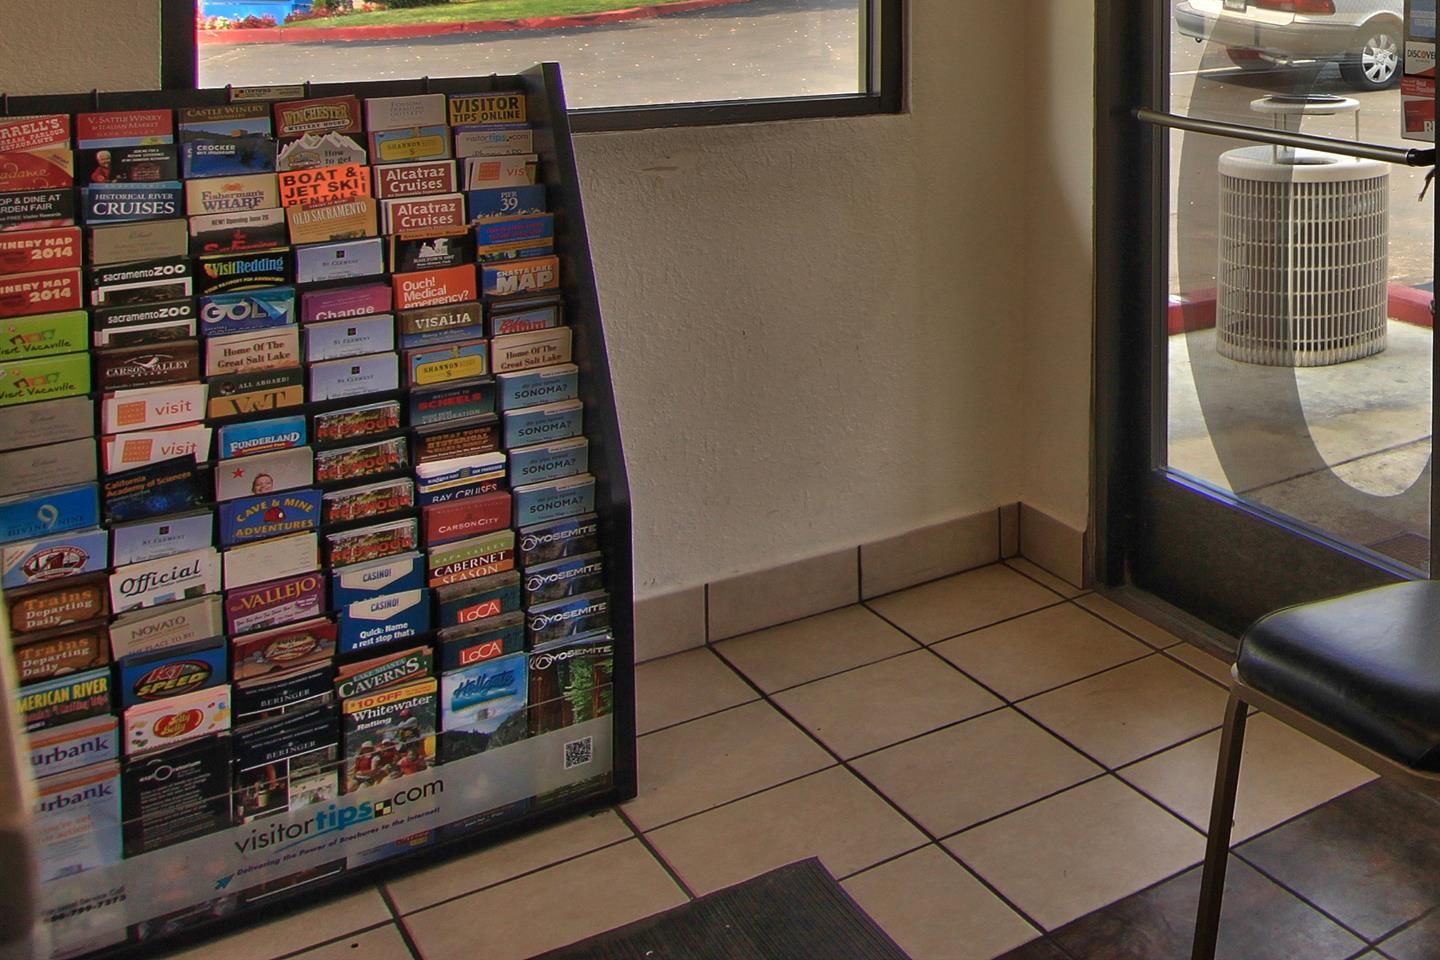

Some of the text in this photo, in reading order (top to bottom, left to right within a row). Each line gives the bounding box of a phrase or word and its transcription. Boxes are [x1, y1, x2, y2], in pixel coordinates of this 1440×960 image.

[1407, 49, 1435, 59] DISCOVE
[187, 107, 222, 117] CASTLE
[224, 105, 263, 114] WINERY
[453, 97, 519, 113] VISITOR
[282, 104, 349, 125] WINCHESTER
[454, 110, 520, 122] TIPS ONLINE
[0, 119, 60, 139] RRELL'S
[283, 167, 356, 186] BOAT &
[386, 167, 445, 181] Alcatraz
[285, 179, 358, 198] JET SKI
[390, 179, 442, 192] Cruises
[23, 195, 46, 204] DINE
[201, 190, 264, 200] Fisherman's
[30, 203, 52, 211] FAIR
[93, 201, 175, 216] CRUISES
[203, 197, 264, 212] WHARF
[398, 203, 456, 215] Alcatraz
[501, 197, 518, 211] 39
[293, 212, 310, 225] OLD
[311, 202, 367, 222] SACRAMENTO
[402, 214, 454, 228] Cruises
[0, 237, 72, 250] INERY MAP
[32, 247, 72, 259] 2014
[496, 268, 529, 279] SHASTA
[496, 271, 553, 292] MAP
[0, 279, 71, 294] INERY MAP
[403, 277, 435, 291] Ouch!
[29, 288, 71, 302] 2014
[404, 285, 447, 302] Medical
[404, 290, 469, 309] emergency?
[201, 298, 280, 323] GOL
[415, 313, 472, 328] VISALIA
[24, 339, 71, 351] Vacaville
[223, 341, 284, 357] Home Of The
[506, 345, 557, 360] Home Of The
[218, 351, 290, 368] Great Salt Lake
[501, 354, 562, 370] Great Salt Lake
[106, 360, 189, 377] CARSON VALLEY
[27, 383, 76, 395] Vacaville
[256, 377, 289, 386] ABOARD!
[514, 383, 568, 399] SONOMA?
[155, 400, 192, 416] visit
[518, 421, 572, 437] SONOMA?
[161, 441, 198, 456] visit
[230, 432, 300, 452] FUNDERLAND
[522, 458, 576, 475] SONOMA?
[105, 475, 146, 490] California
[106, 483, 145, 497] Academy
[156, 471, 192, 484] Sciences
[236, 498, 314, 522] CAVE & MINE
[530, 496, 584, 513] SONOMA?
[235, 520, 313, 537] ADVENTURES
[439, 517, 499, 534] CARSON CITY
[536, 524, 597, 543] YOSEMITE
[434, 551, 506, 577] CABERNET
[542, 562, 603, 582] YOSEMITE
[120, 560, 201, 597] Official
[363, 568, 391, 582] CASINO!
[442, 564, 498, 584] SEASON
[25, 591, 91, 610] Trains
[242, 577, 316, 609] VALLEJO
[26, 600, 92, 619] Departing
[371, 597, 399, 612] CASINO!
[546, 602, 607, 623] YOSEMITE
[26, 615, 61, 628] Daily
[131, 615, 185, 639] NOVATO
[385, 622, 408, 633] Name
[359, 638, 374, 648] rest
[376, 633, 393, 645] stop
[394, 629, 415, 639] that's
[20, 638, 88, 658] Trains
[551, 645, 612, 661] YOSEMITE
[22, 648, 90, 667] Departing
[23, 664, 58, 677] Daily
[339, 657, 419, 699] CAVERNS
[73, 678, 107, 699] RIVER
[137, 671, 209, 696] SPEED
[261, 688, 310, 707] BERINGER
[377, 690, 401, 704] OFF
[352, 695, 432, 723] Whitewater
[31, 737, 109, 765] urbank
[266, 741, 315, 759] BERINGER
